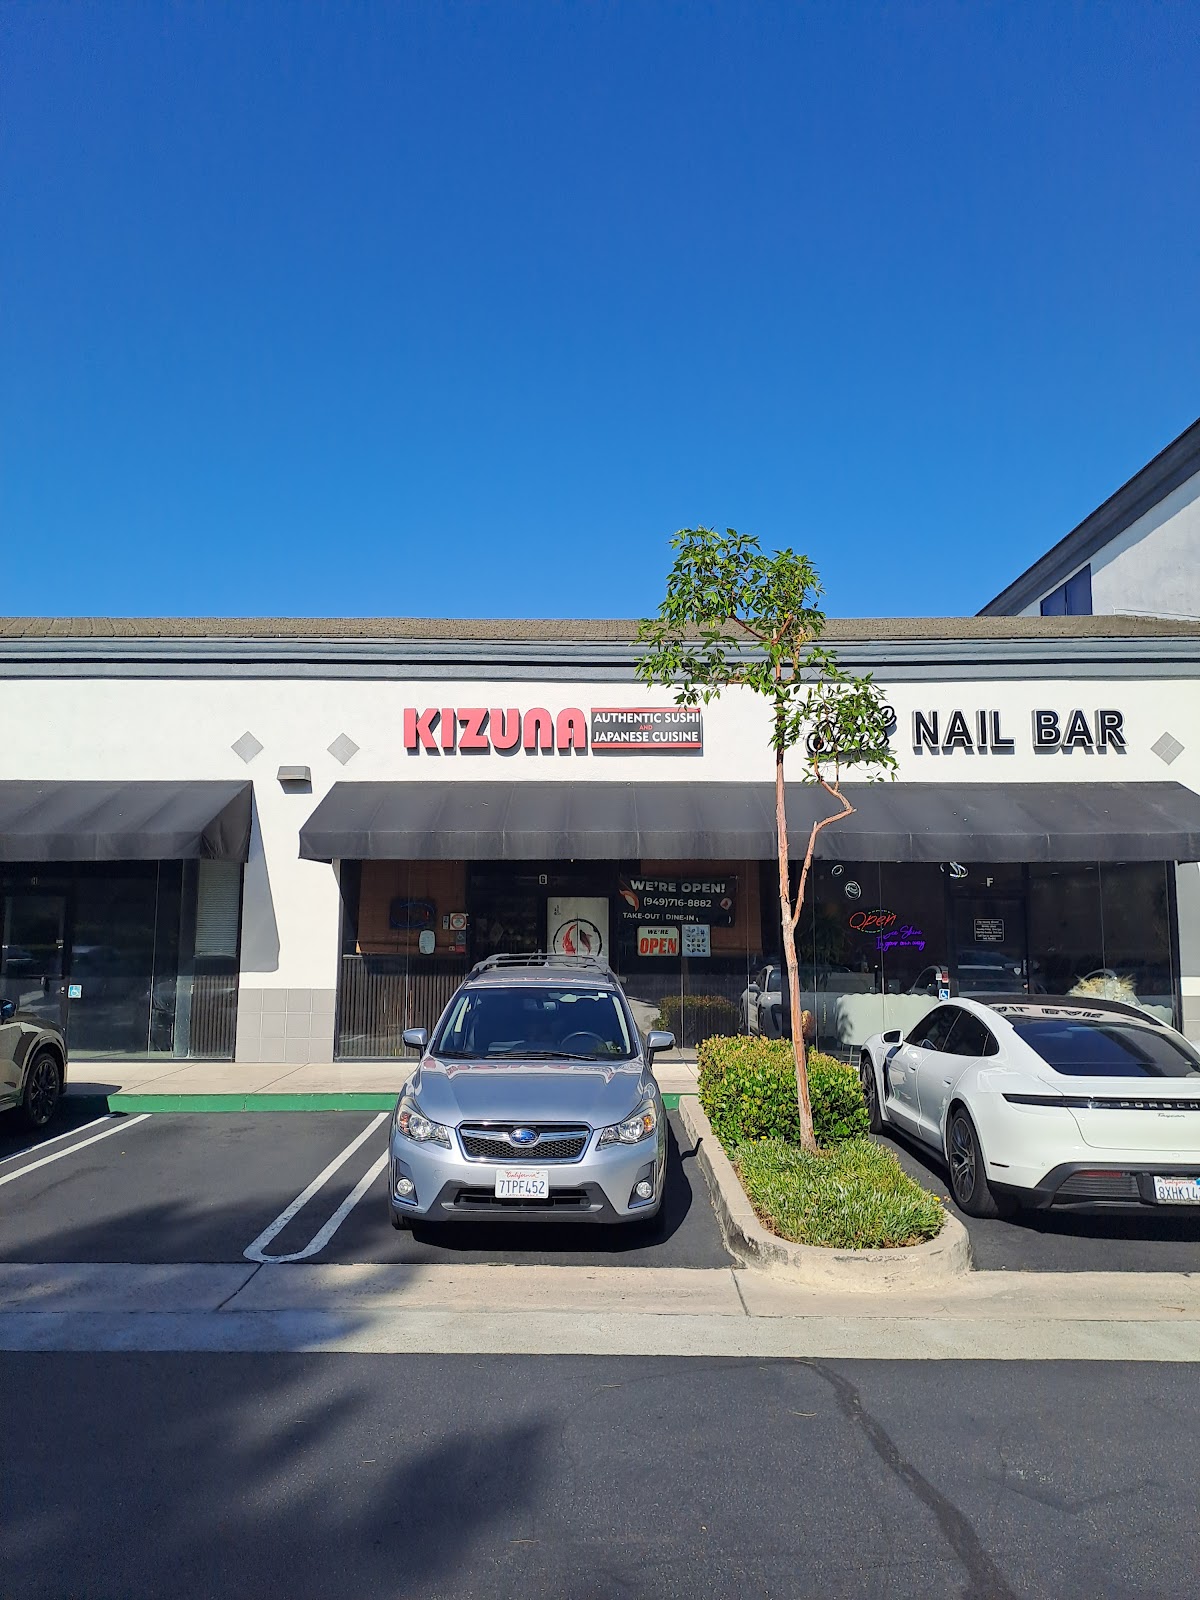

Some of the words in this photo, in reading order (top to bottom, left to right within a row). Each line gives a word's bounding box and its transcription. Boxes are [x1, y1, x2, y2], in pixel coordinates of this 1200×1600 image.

[594, 713, 662, 723] AUTHENTIC
[664, 713, 699, 723] SUSHI
[404, 708, 587, 749] KIZUNA
[913, 709, 1016, 747] NAIL
[1032, 709, 1129, 747] BAR
[594, 731, 649, 742] JAPANESE
[652, 731, 698, 742] CUISINE
[630, 880, 677, 892] WE'RE
[681, 883, 726, 894] OPEN!
[986, 877, 994, 887] F
[643, 897, 712, 908] (949)716-8882
[622, 912, 660, 920] TAKE-OUT
[665, 914, 695, 922] DINE-IN
[849, 911, 897, 931] Open
[639, 937, 677, 955] OPEN
[506, 1170, 538, 1180] California
[499, 1180, 545, 1194] 7TPF452
[1158, 1186, 1200, 1201] 8XHK14
